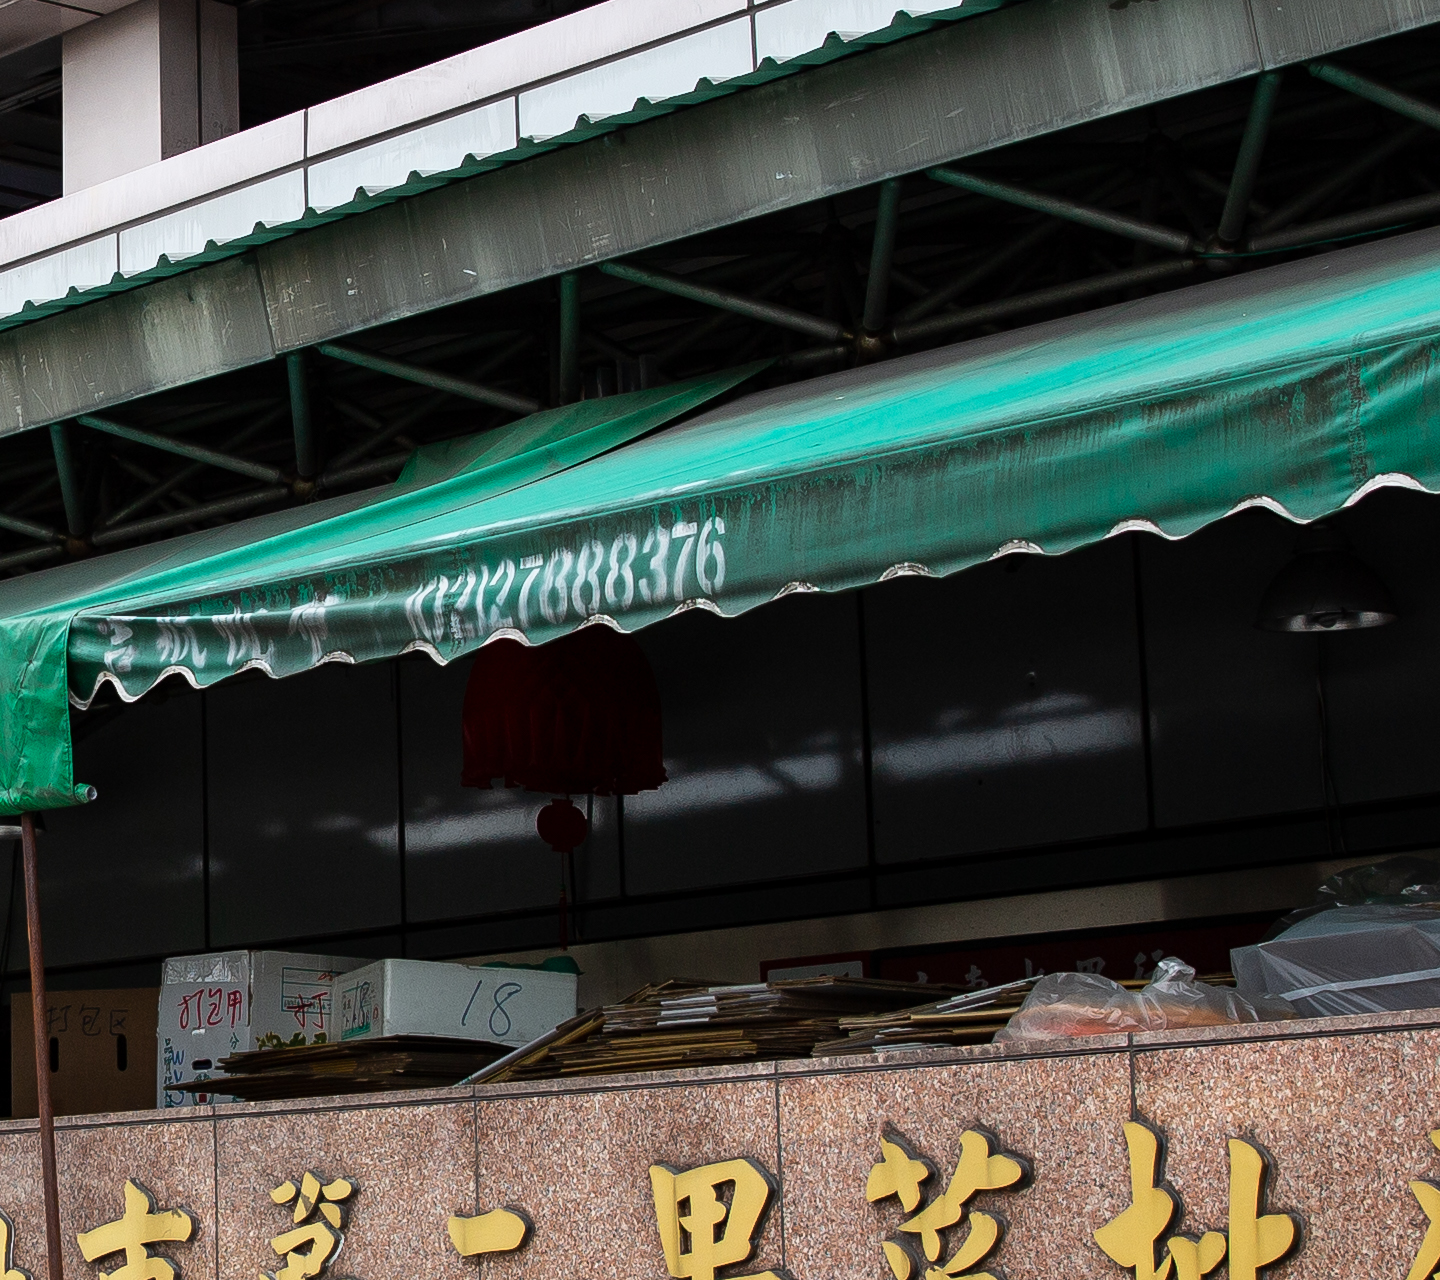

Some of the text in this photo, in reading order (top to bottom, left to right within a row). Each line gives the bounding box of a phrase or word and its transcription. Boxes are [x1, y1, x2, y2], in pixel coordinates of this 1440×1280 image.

[177, 987, 244, 1030] 打包用
[461, 979, 523, 1037] 18
